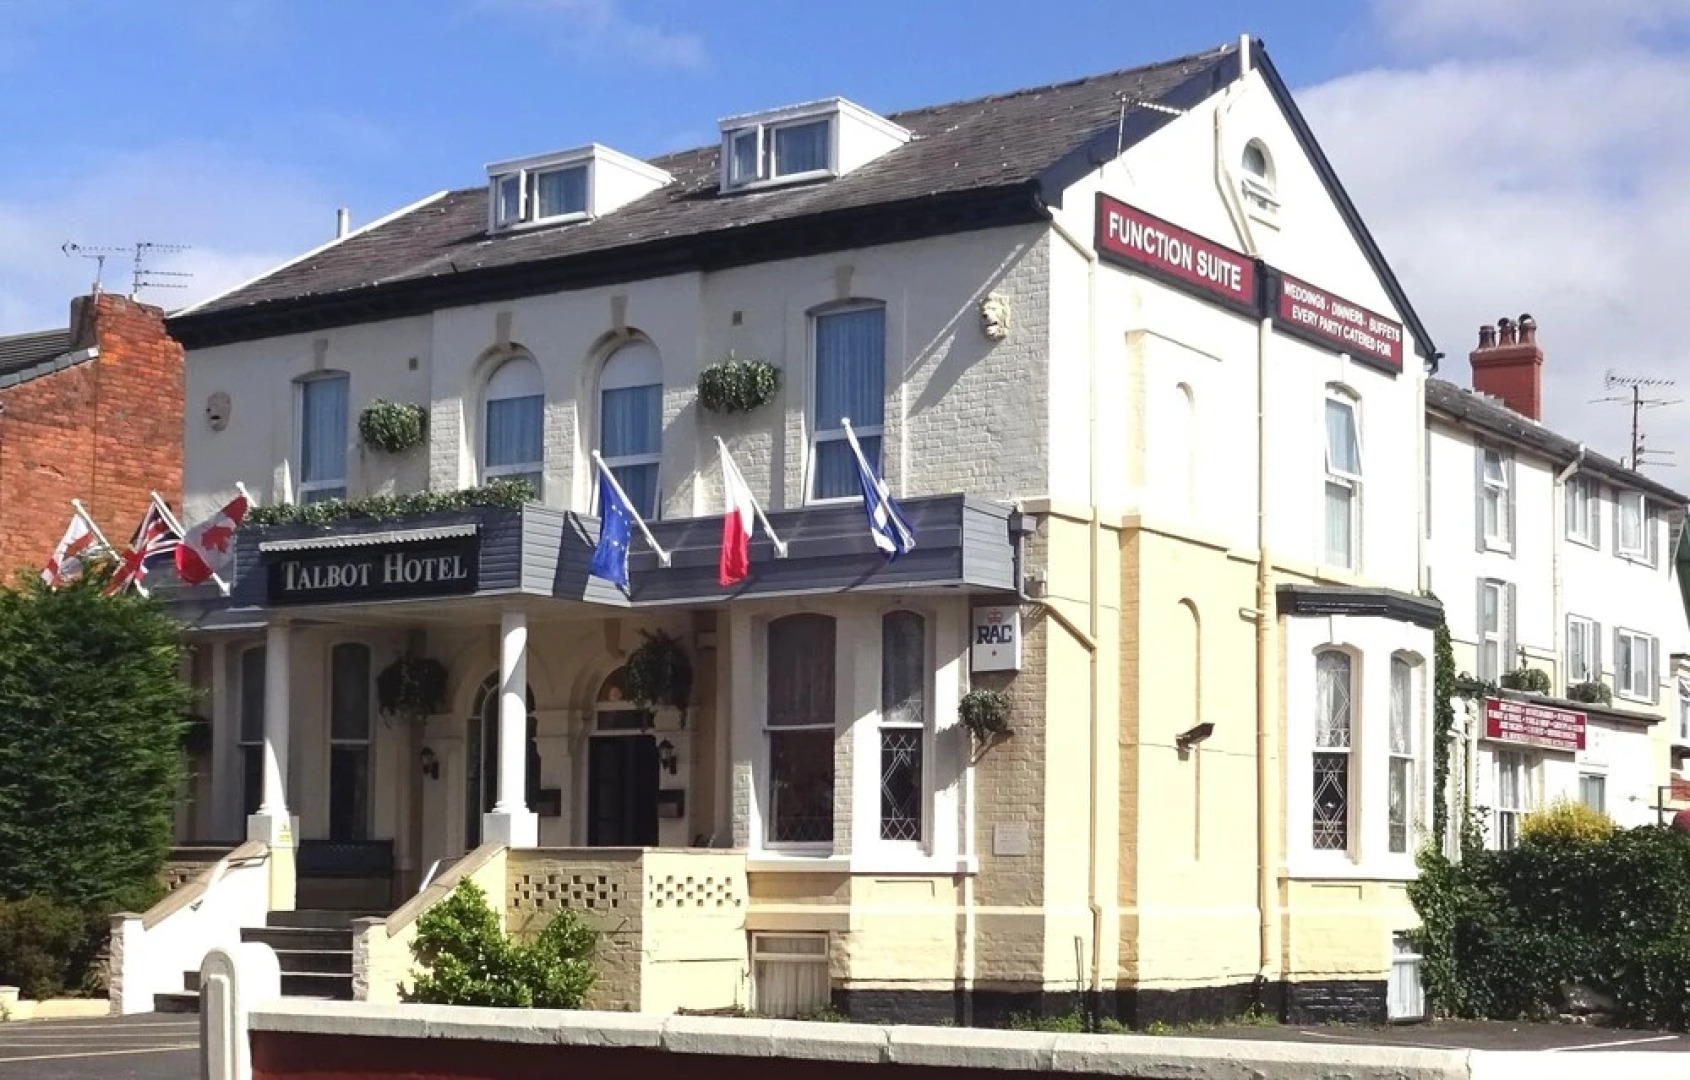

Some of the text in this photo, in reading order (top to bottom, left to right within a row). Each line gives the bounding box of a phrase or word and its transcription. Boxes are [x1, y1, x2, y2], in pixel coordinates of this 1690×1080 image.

[1108, 211, 1242, 291] FUNCTION SUITE
[1284, 281, 1400, 341] WEDDINGS DINNERS BUFFETS
[1292, 305, 1391, 358] EVERY PARTY CATERED FOR
[281, 552, 467, 591] TALBOT HOTEL
[976, 624, 1013, 644] RAC
